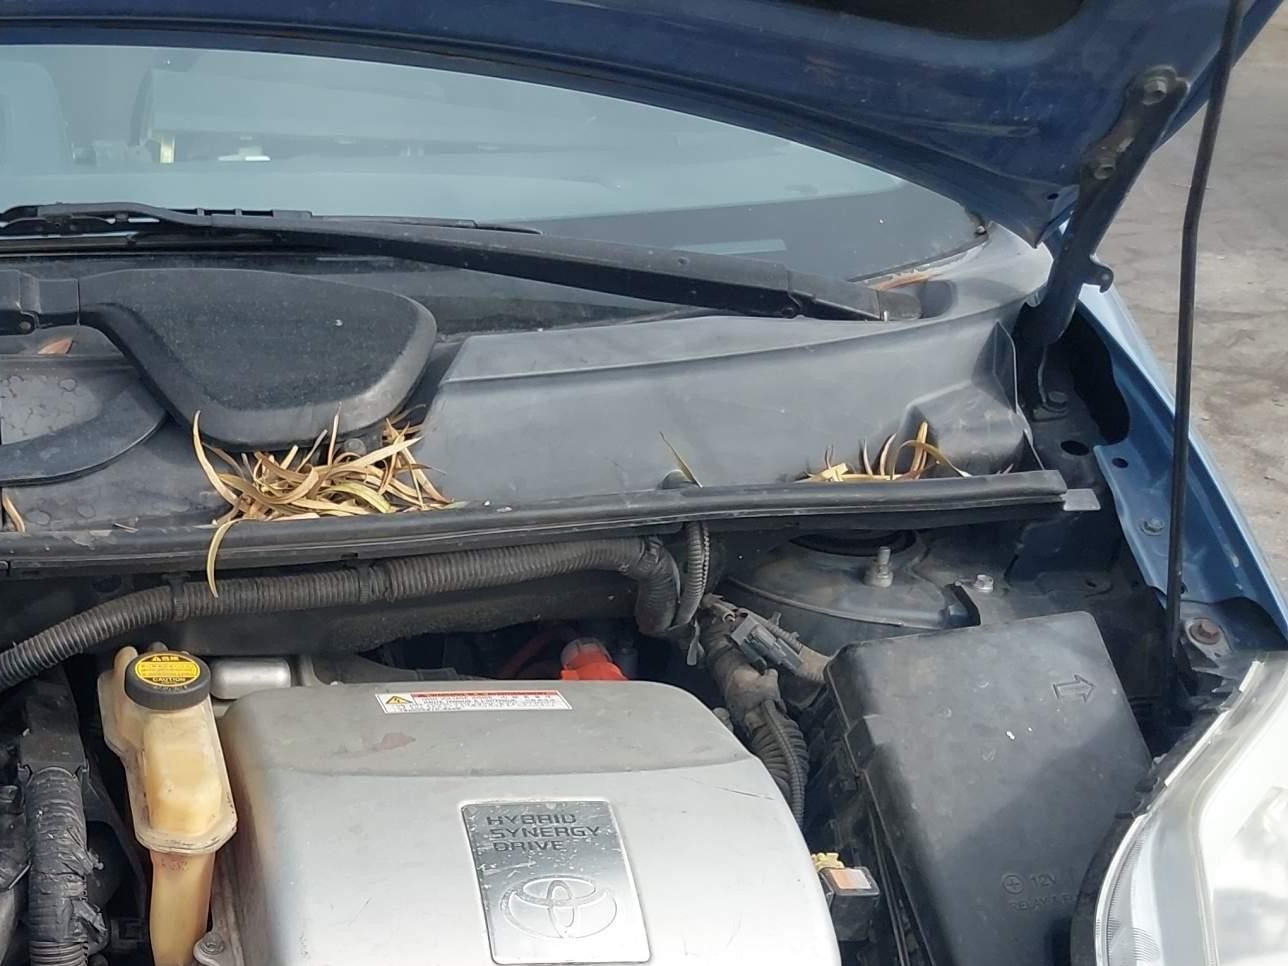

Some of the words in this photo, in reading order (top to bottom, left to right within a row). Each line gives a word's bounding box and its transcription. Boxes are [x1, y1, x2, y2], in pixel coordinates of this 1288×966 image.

[486, 814, 576, 825] HYBRID
[489, 826, 600, 839] SYNERGY
[493, 840, 564, 852] DRIVE
